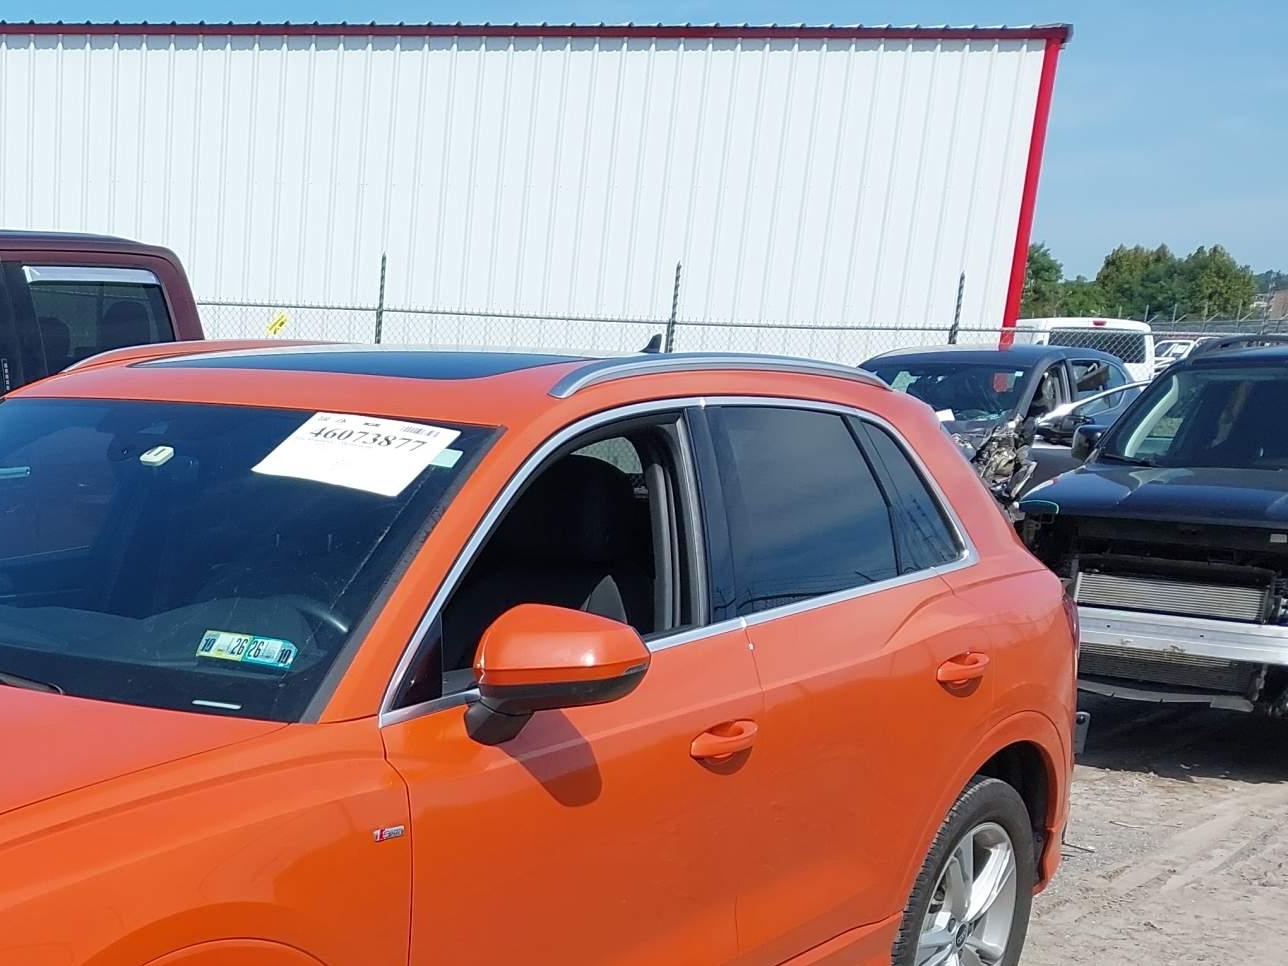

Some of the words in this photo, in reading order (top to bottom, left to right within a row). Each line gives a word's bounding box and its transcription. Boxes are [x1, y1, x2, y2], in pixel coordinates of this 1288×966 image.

[309, 427, 428, 451] 46073877
[230, 638, 248, 656] 26
[247, 640, 264, 658] 26
